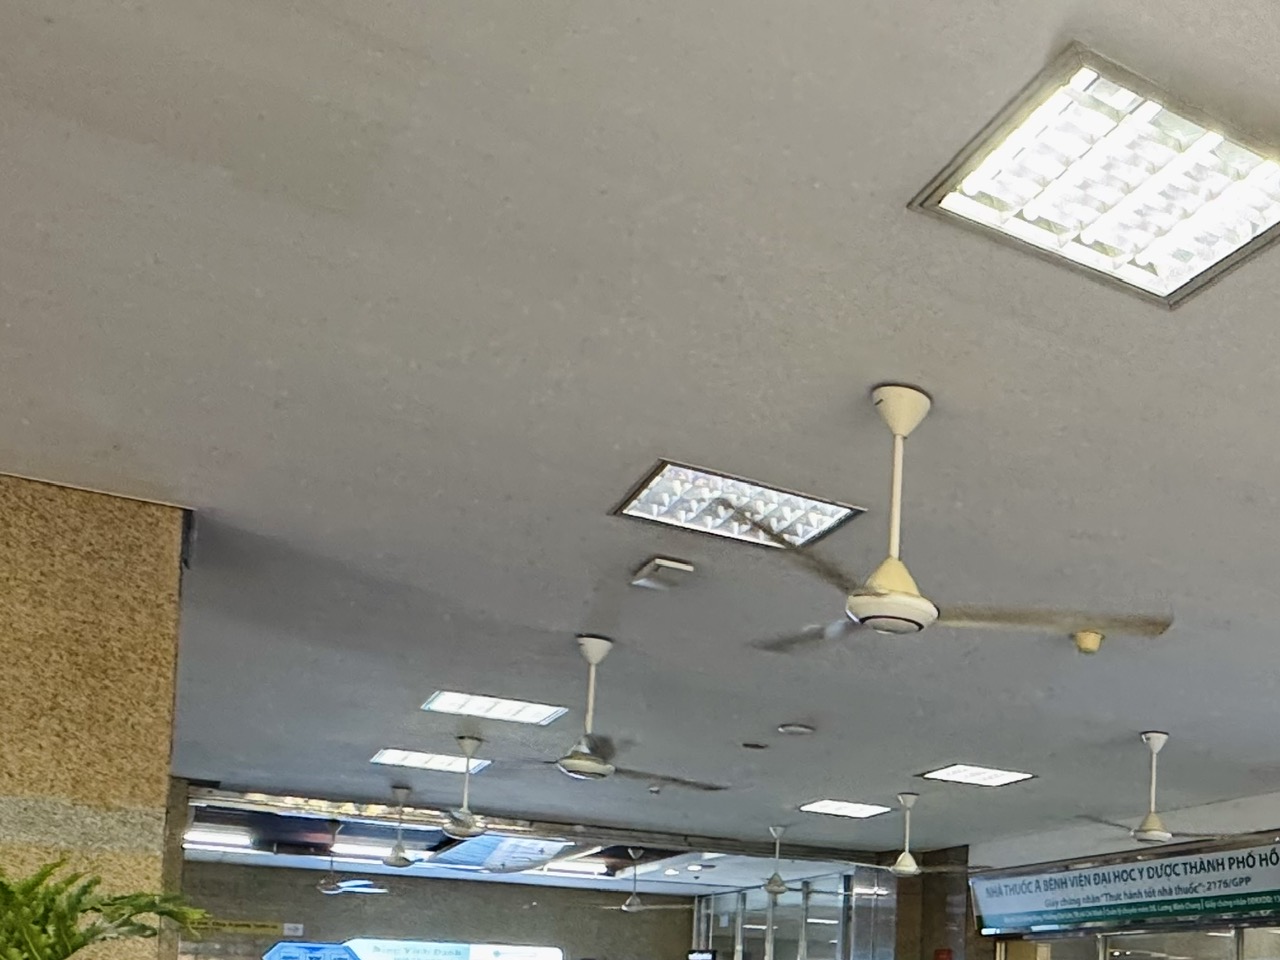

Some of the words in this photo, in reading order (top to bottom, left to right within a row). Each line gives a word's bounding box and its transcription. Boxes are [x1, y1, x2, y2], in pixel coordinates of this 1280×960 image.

[1003, 879, 1034, 897] THUỐC
[1043, 876, 1068, 895] BỆNH
[1068, 872, 1091, 890] VIỆN
[1093, 870, 1112, 888] ĐẠI
[1113, 868, 1137, 885] HỌC
[1137, 867, 1145, 880] Y
[1146, 863, 1181, 881] DƯỢC
[1182, 857, 1226, 875] THÀNH
[1228, 850, 1256, 871] PHỐ
[1259, 847, 1280, 867] HỒ
[1157, 886, 1173, 897] nhà
